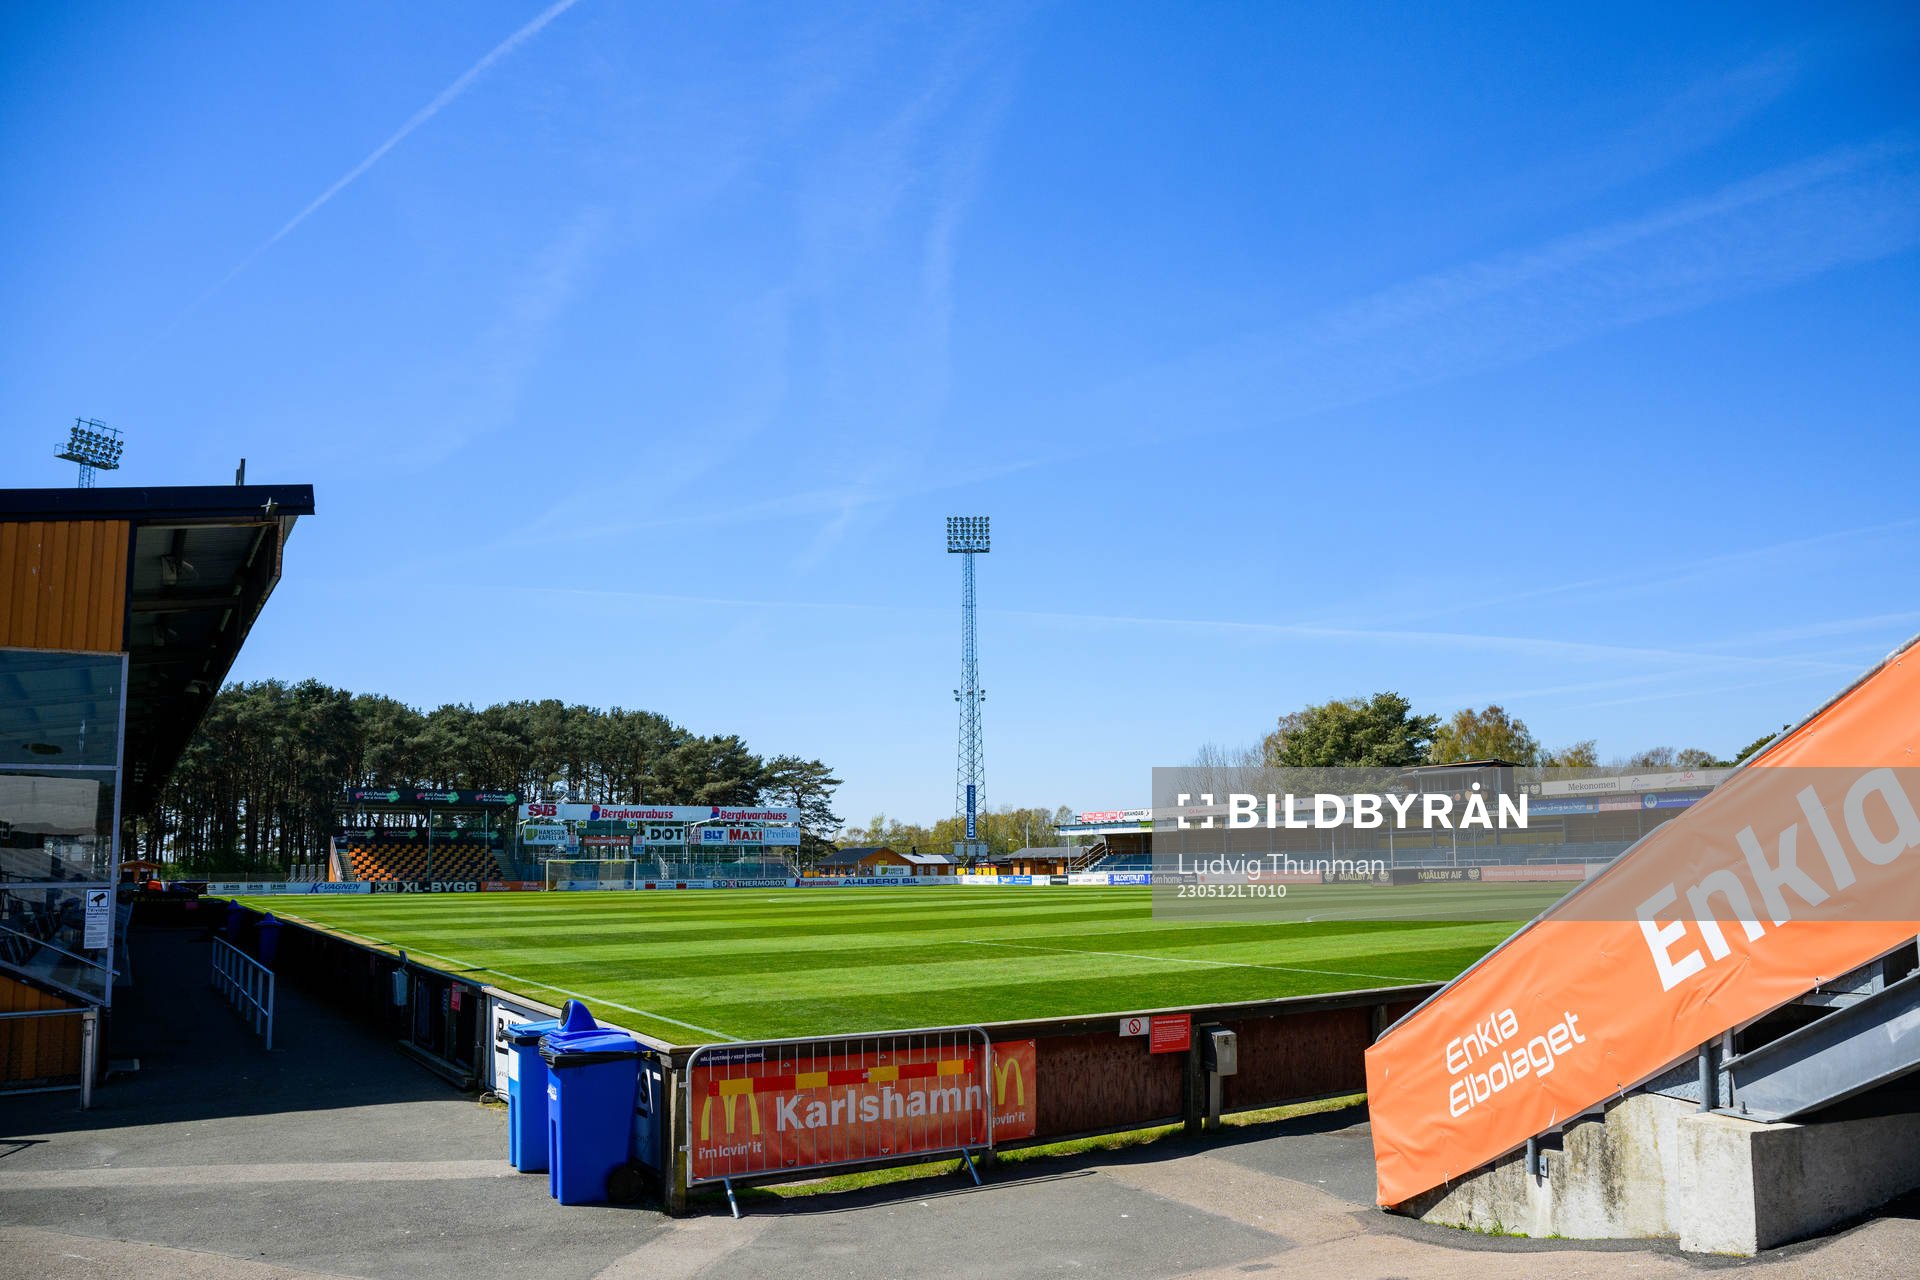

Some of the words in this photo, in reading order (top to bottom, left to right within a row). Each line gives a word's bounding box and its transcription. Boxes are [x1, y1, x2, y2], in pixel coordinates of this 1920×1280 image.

[1567, 781, 1617, 791] Mekonomen
[601, 808, 674, 820] Bergkvarabuss
[721, 809, 787, 822] Bergkvarabuss
[703, 830, 724, 840] BLT
[766, 829, 799, 839] ProFast
[1418, 871, 1450, 880] MJÄLLBY
[1451, 871, 1462, 879] AIF
[1635, 767, 1920, 992] Enkla
[310, 882, 361, 893] K-VAGNEN
[402, 881, 477, 892] XL-BYGG
[1446, 1008, 1519, 1075] Enkla
[1449, 1011, 1586, 1118] Elbolaget
[776, 1082, 982, 1132] Karlshamn
[753, 1141, 762, 1153] it
